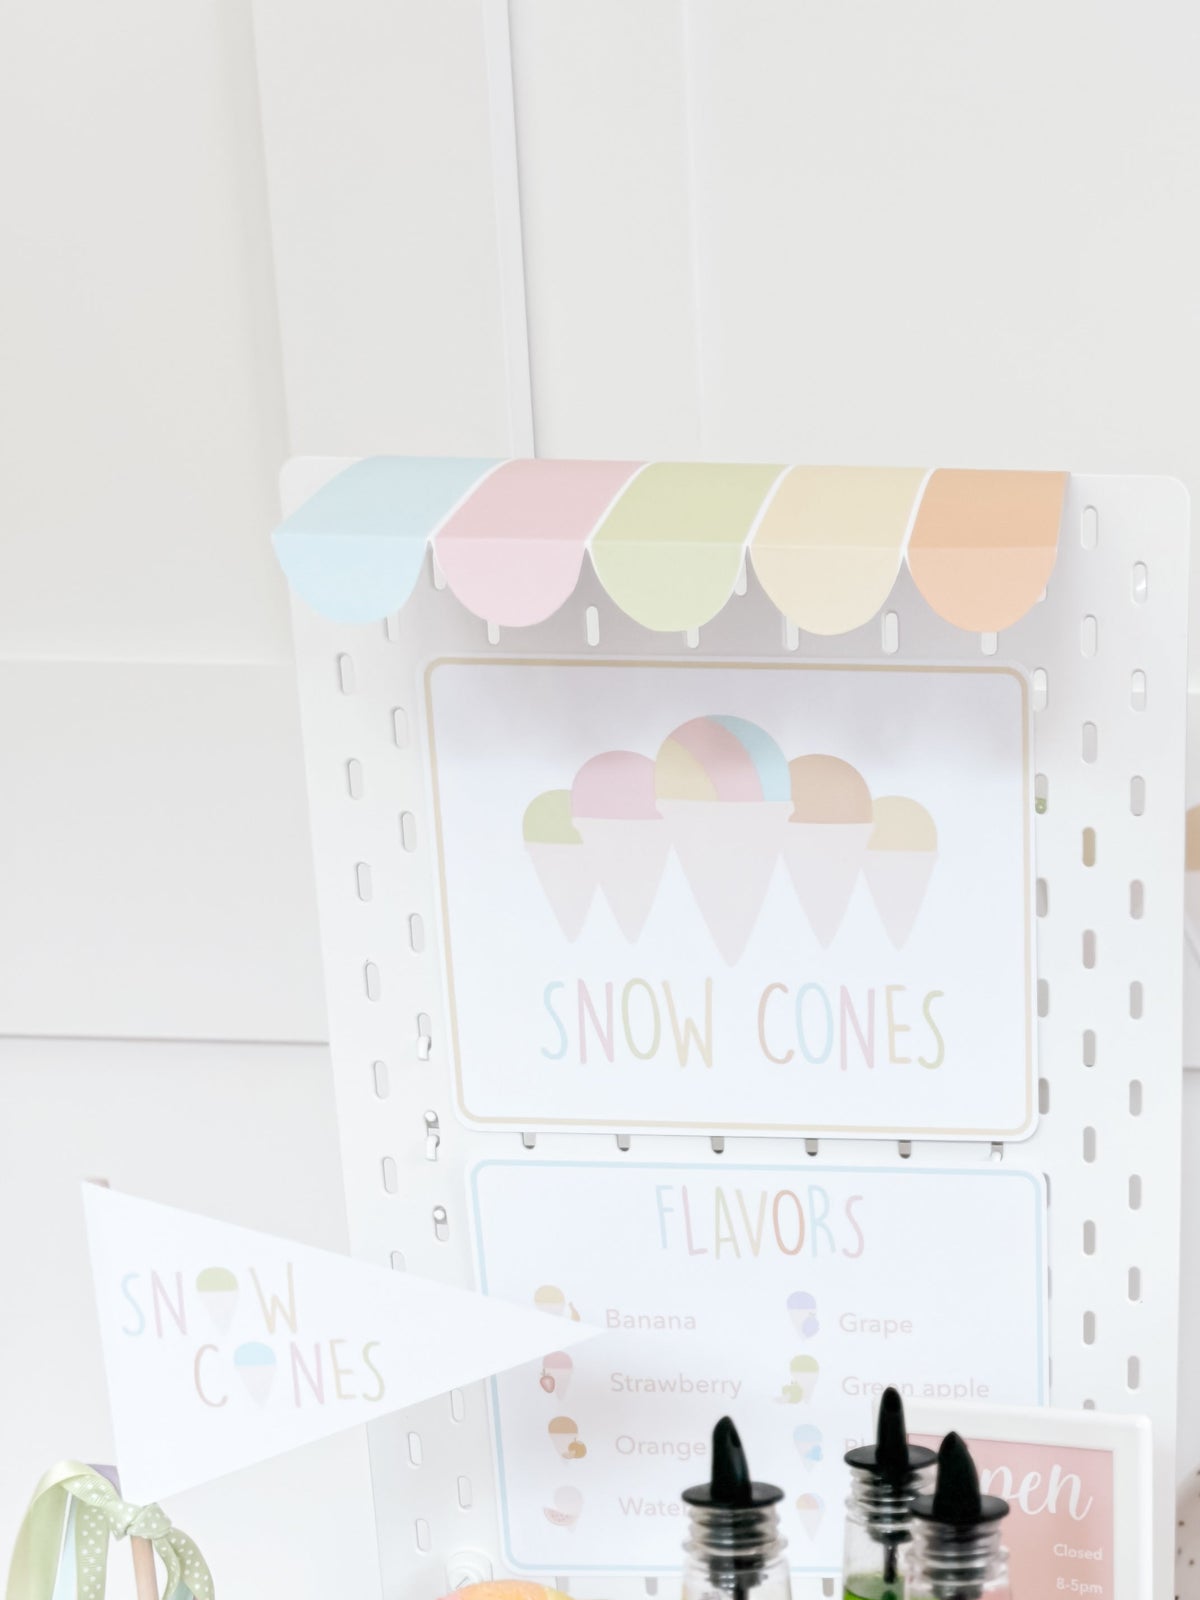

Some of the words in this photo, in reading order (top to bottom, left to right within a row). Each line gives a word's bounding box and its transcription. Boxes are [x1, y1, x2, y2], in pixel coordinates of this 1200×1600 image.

[539, 978, 713, 1070] SNOW
[757, 984, 946, 1071] CONES
[655, 1183, 865, 1260] FLAVORS
[606, 1309, 696, 1331] Banana
[839, 1313, 913, 1339] Grape
[611, 1373, 742, 1398] Strawberry
[615, 1436, 706, 1459] Orange
[981, 1464, 1093, 1521] pen
[1053, 1544, 1103, 1561] Closed
[1056, 1578, 1103, 1594] 8-5pm
